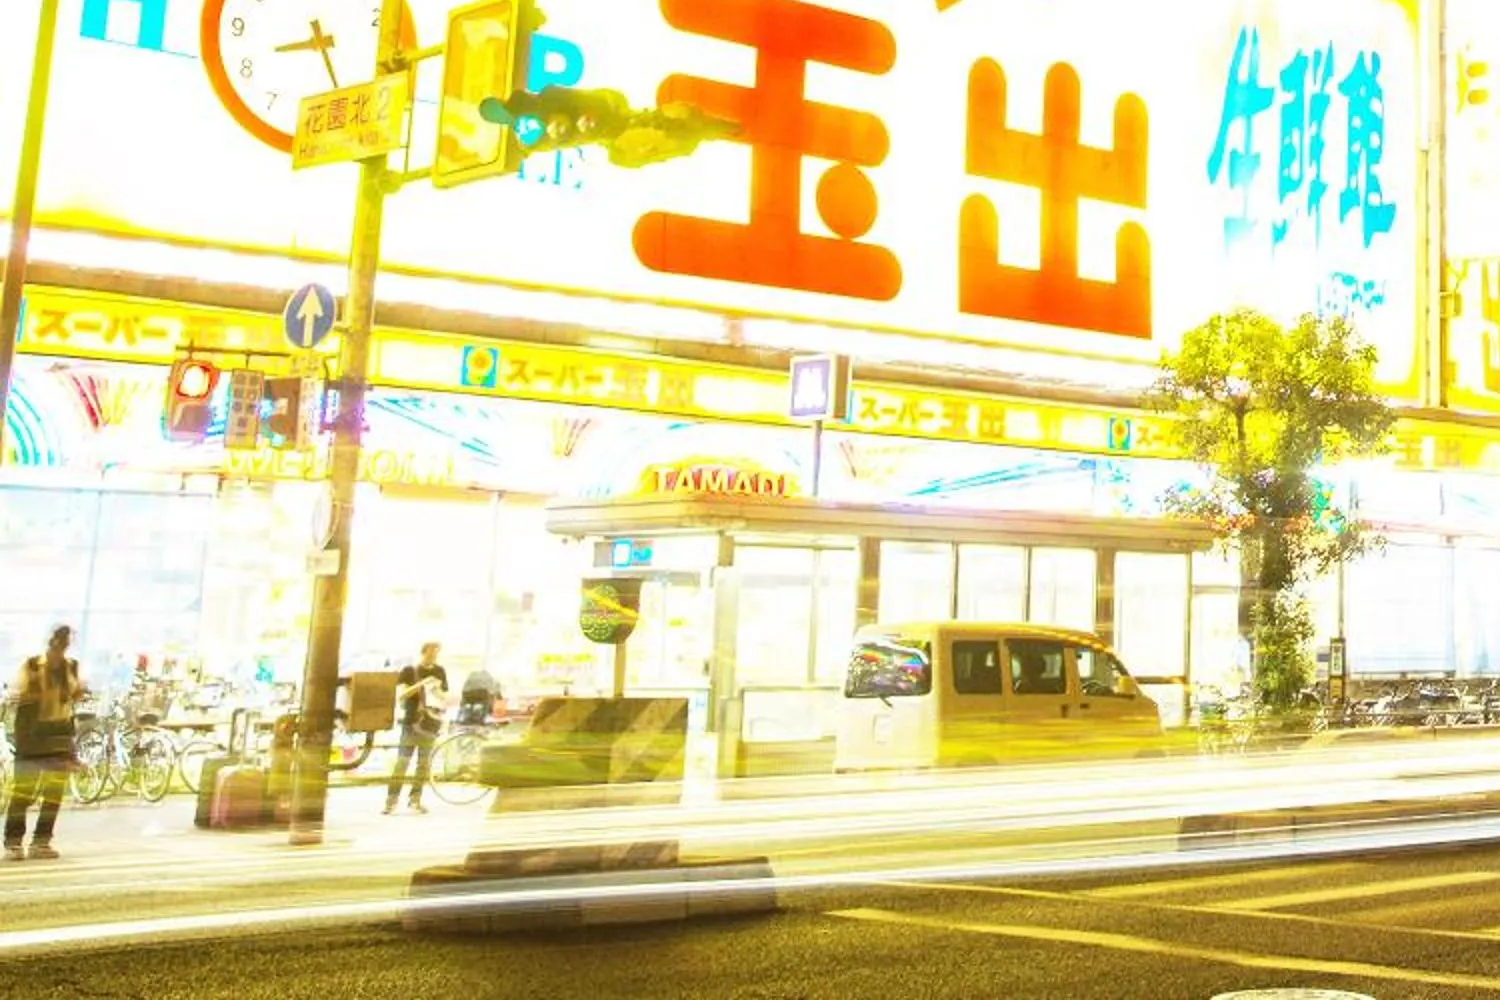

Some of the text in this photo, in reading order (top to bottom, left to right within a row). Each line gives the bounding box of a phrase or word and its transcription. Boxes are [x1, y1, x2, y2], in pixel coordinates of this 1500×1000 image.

[231, 17, 246, 37] 9
[239, 57, 253, 79] 8
[265, 90, 279, 111] 7
